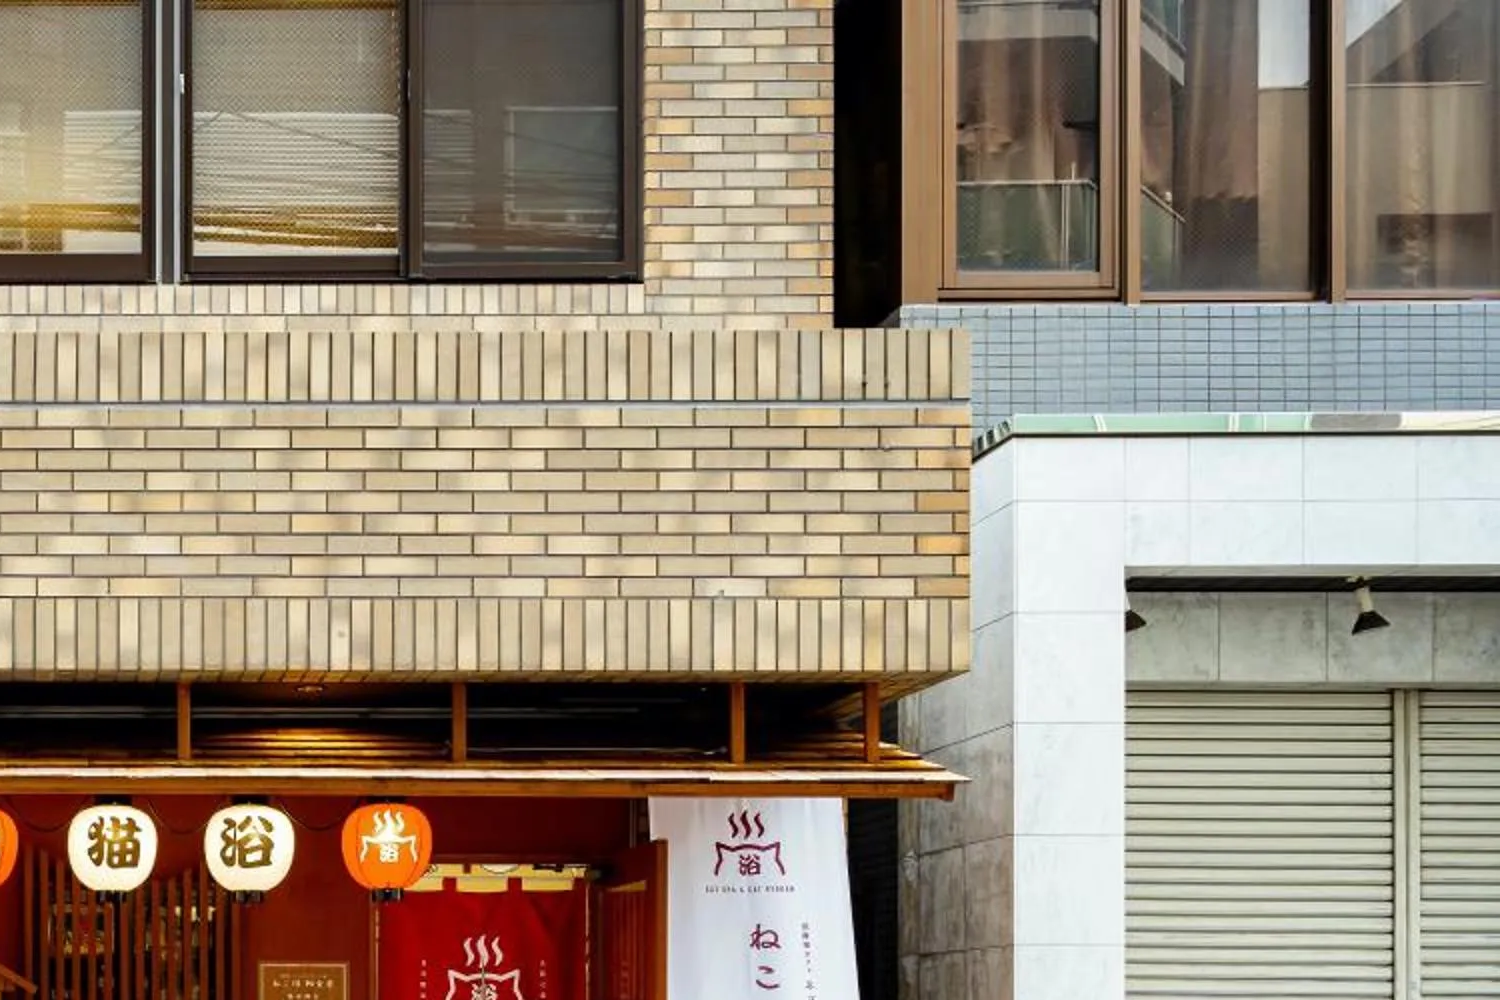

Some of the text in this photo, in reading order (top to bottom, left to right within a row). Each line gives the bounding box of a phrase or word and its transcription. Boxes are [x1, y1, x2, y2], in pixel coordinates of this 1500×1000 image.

[87, 815, 275, 869] 猫 浴
[738, 854, 761, 876] 浴
